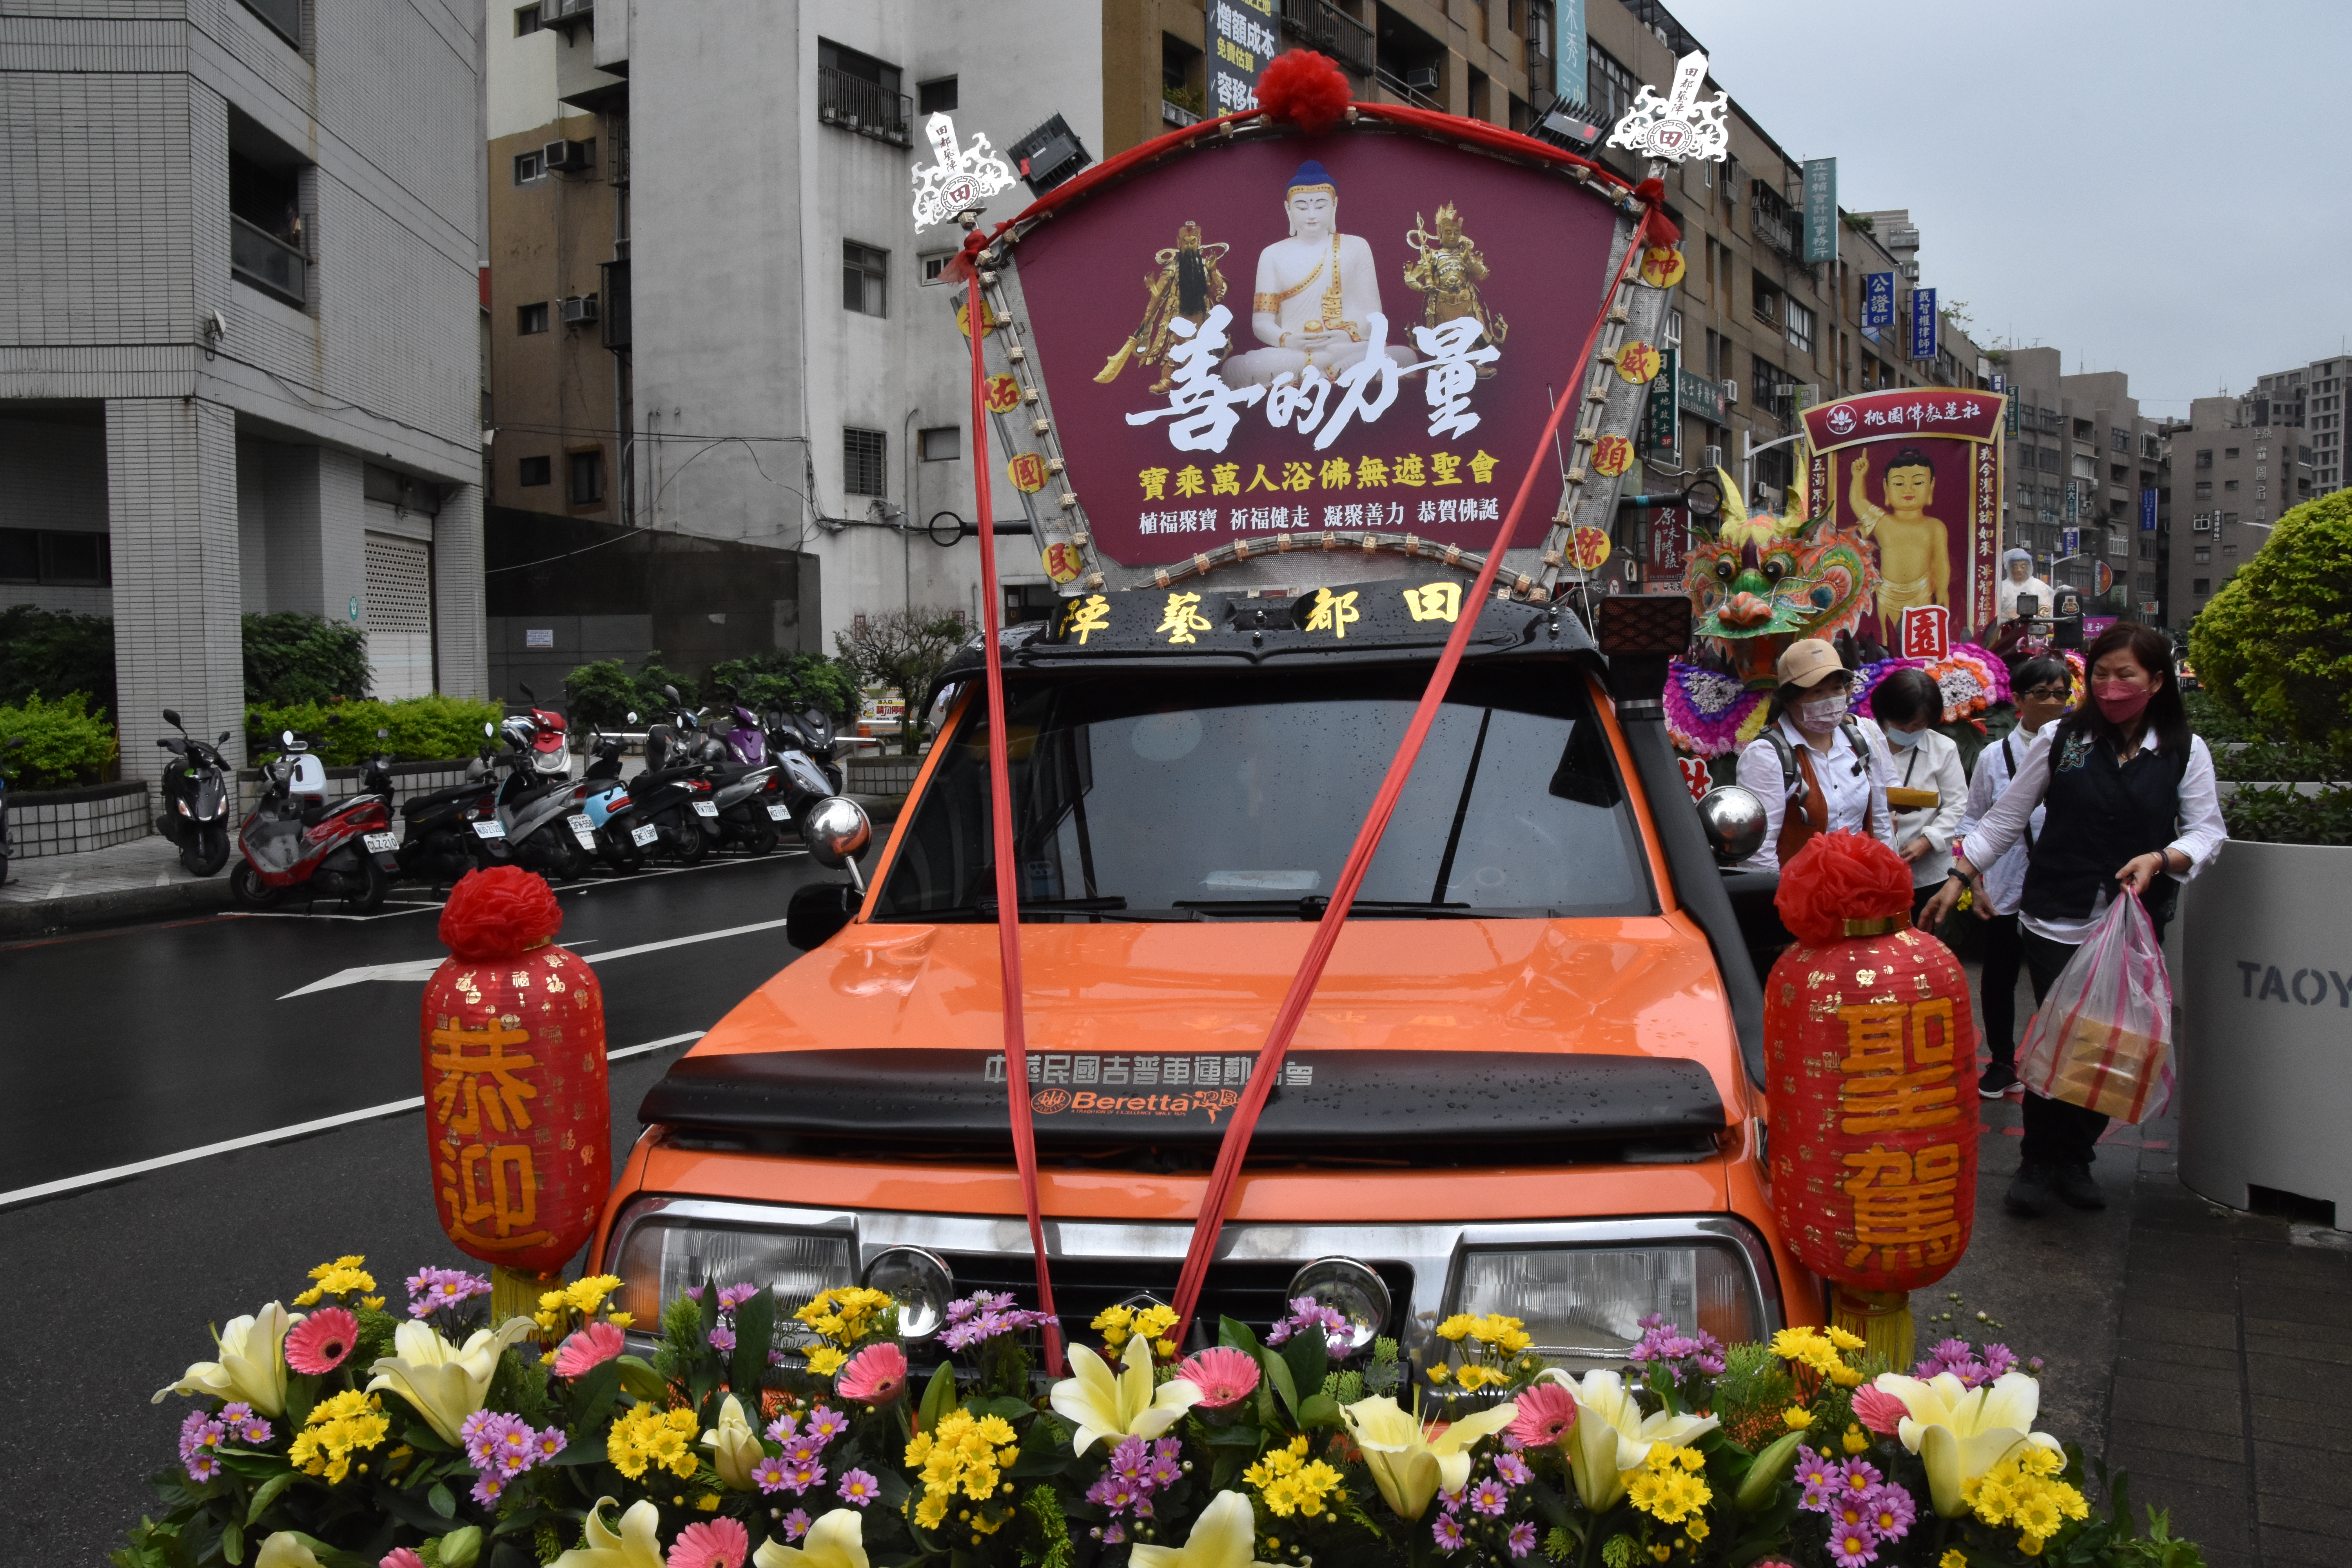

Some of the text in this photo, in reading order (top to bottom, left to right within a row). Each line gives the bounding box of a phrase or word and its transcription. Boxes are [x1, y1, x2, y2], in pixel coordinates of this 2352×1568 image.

[1217, 2, 1275, 60] 增額成本
[1217, 37, 1254, 73] 免費估算
[1671, 68, 1699, 115] 田都藝陣
[936, 125, 958, 172] 田都藝陣
[1660, 130, 1683, 148] 田
[949, 184, 970, 203] 田
[1871, 275, 1890, 313] 公證
[1126, 304, 1501, 453] 善的力量
[1660, 396, 1670, 433] 地政士
[1864, 401, 1981, 430] 桃園佛教蓮社
[1138, 450, 1500, 501] 寶乘萬人浴佛無遮聖會
[1139, 498, 1499, 535] 植福聚寶 祈福健走 凝聚善力 恭賀佛誕
[1654, 507, 1681, 568] 原味時蔬
[1905, 608, 1947, 660] 園
[2083, 622, 2104, 632] 蓮社
[367, 838, 397, 850] CLZ-210
[2236, 960, 2352, 1008] TAOY
[984, 1054, 1313, 1086] 中華民國吉普車運動會
[1071, 1091, 1189, 1111] Beretta
[431, 1016, 550, 1250] 恭迎
